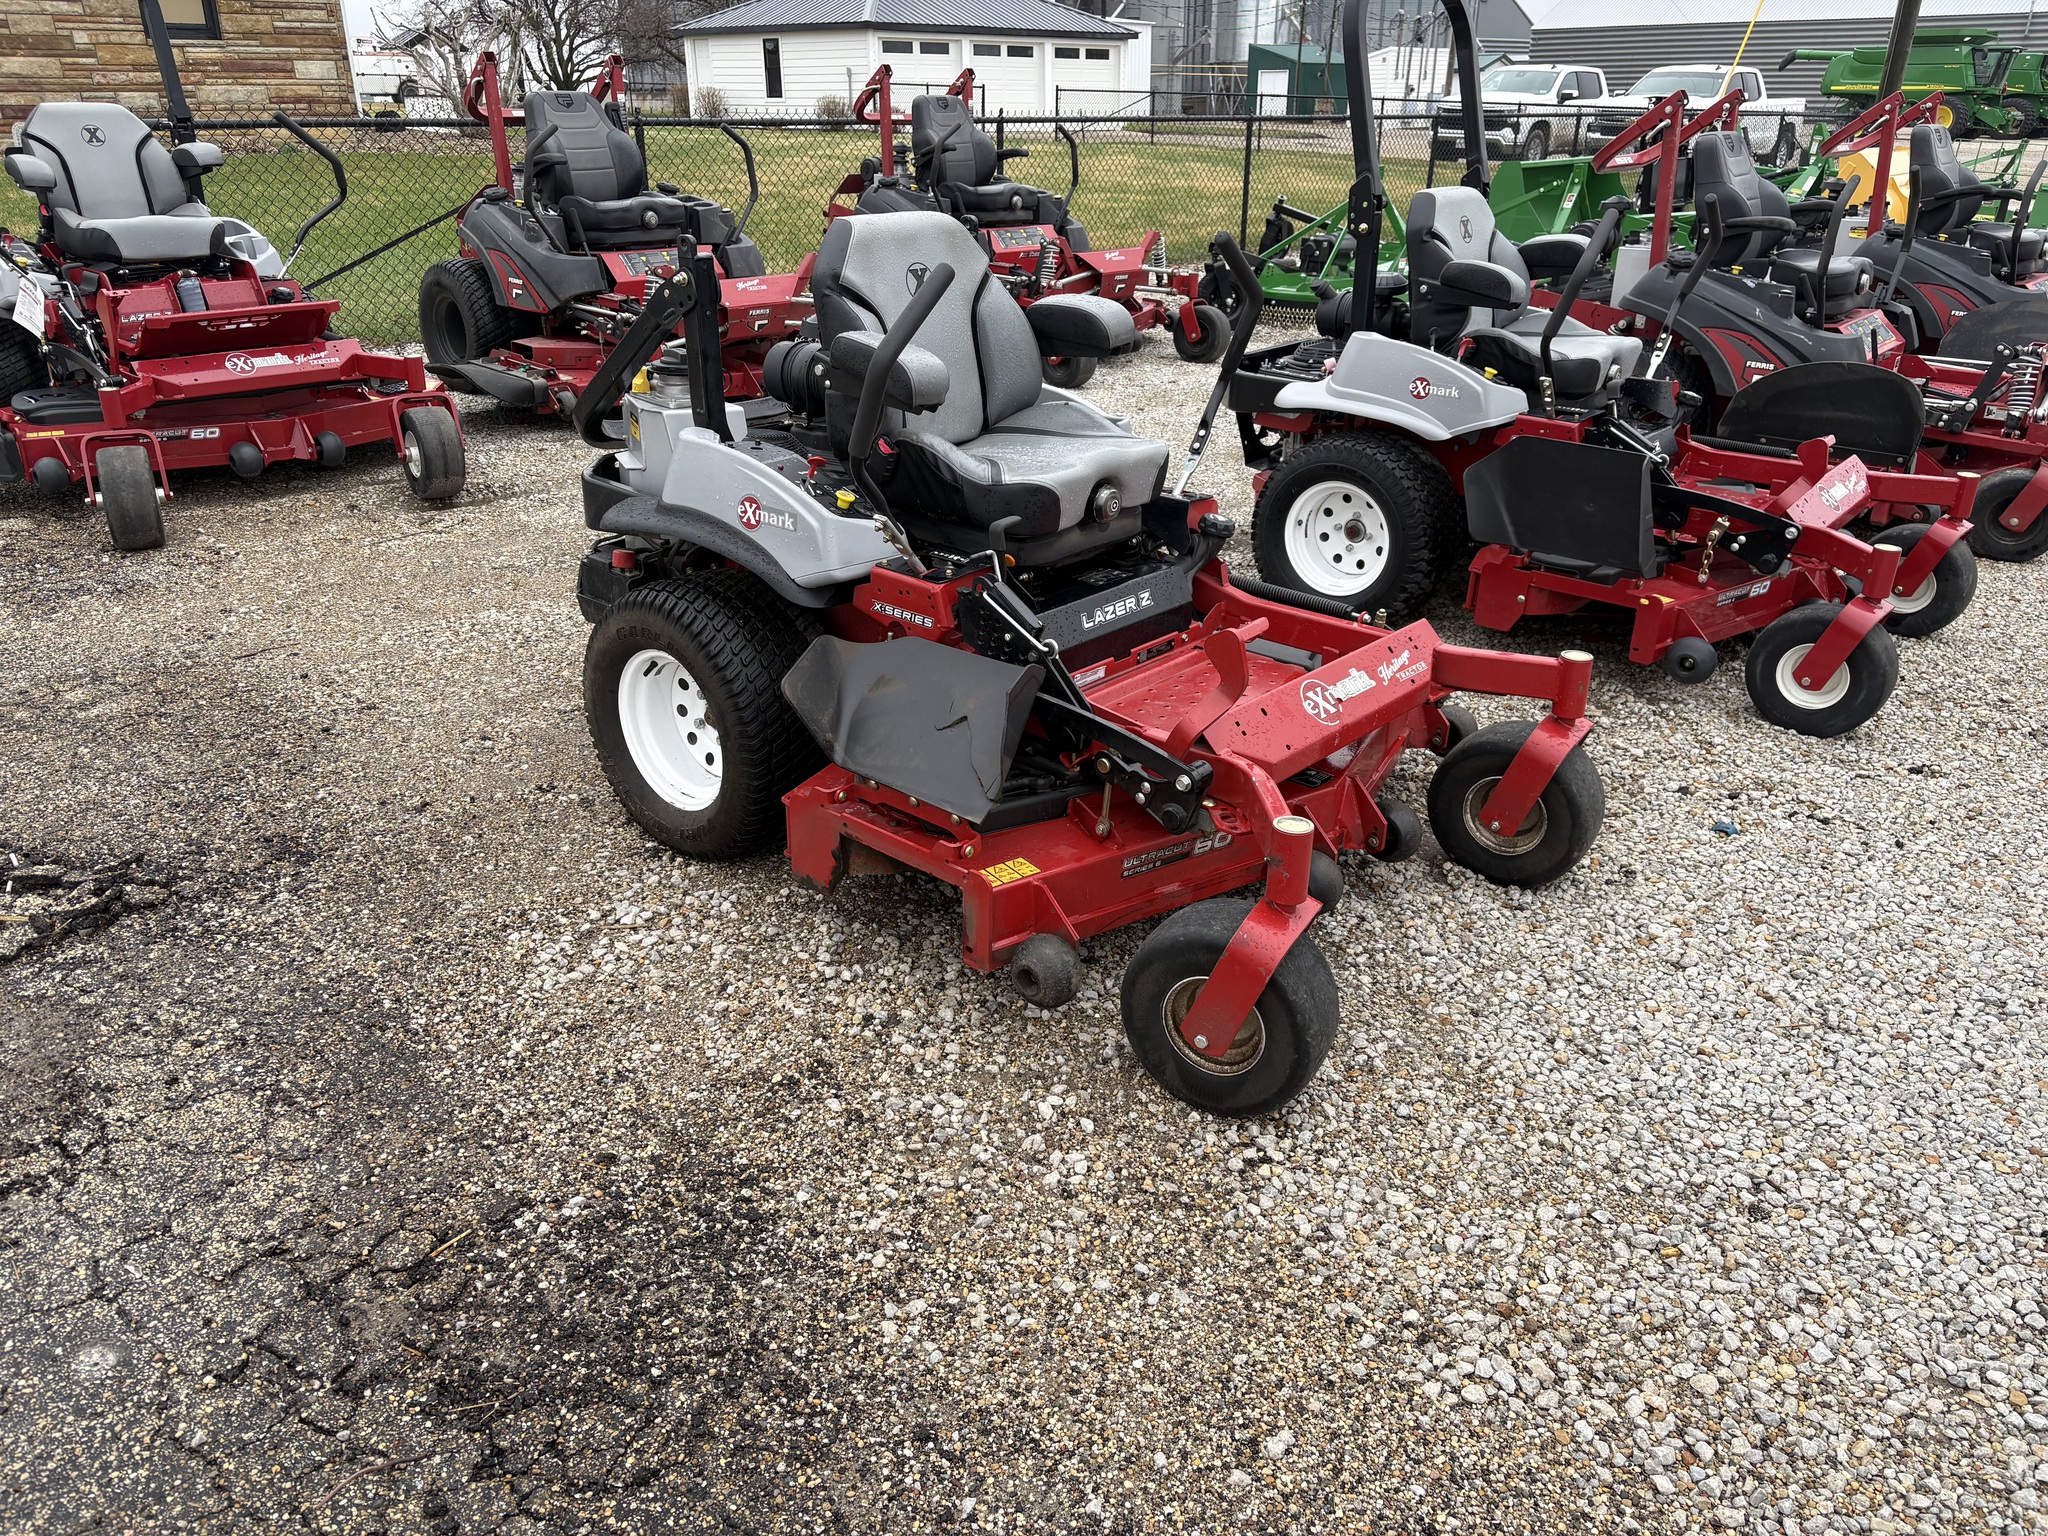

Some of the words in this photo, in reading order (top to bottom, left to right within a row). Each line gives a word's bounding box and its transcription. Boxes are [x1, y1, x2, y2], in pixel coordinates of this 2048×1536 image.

[749, 308, 770, 317] FERRIS
[1746, 360, 1775, 371] FERRIS
[1409, 379, 1459, 399] eXmark
[190, 428, 220, 440] 60
[737, 499, 795, 532] eXmark
[1750, 580, 1771, 597] 60
[1081, 595, 1139, 631] LAZER
[1138, 589, 1154, 609] Z
[1377, 649, 1411, 685] Heritage
[1396, 661, 1429, 682] TRACTOR
[1302, 668, 1376, 719] eXmark
[1122, 840, 1192, 868] ULTRACUT
[1192, 832, 1232, 855] 60
[1122, 863, 1154, 877] SERIES
